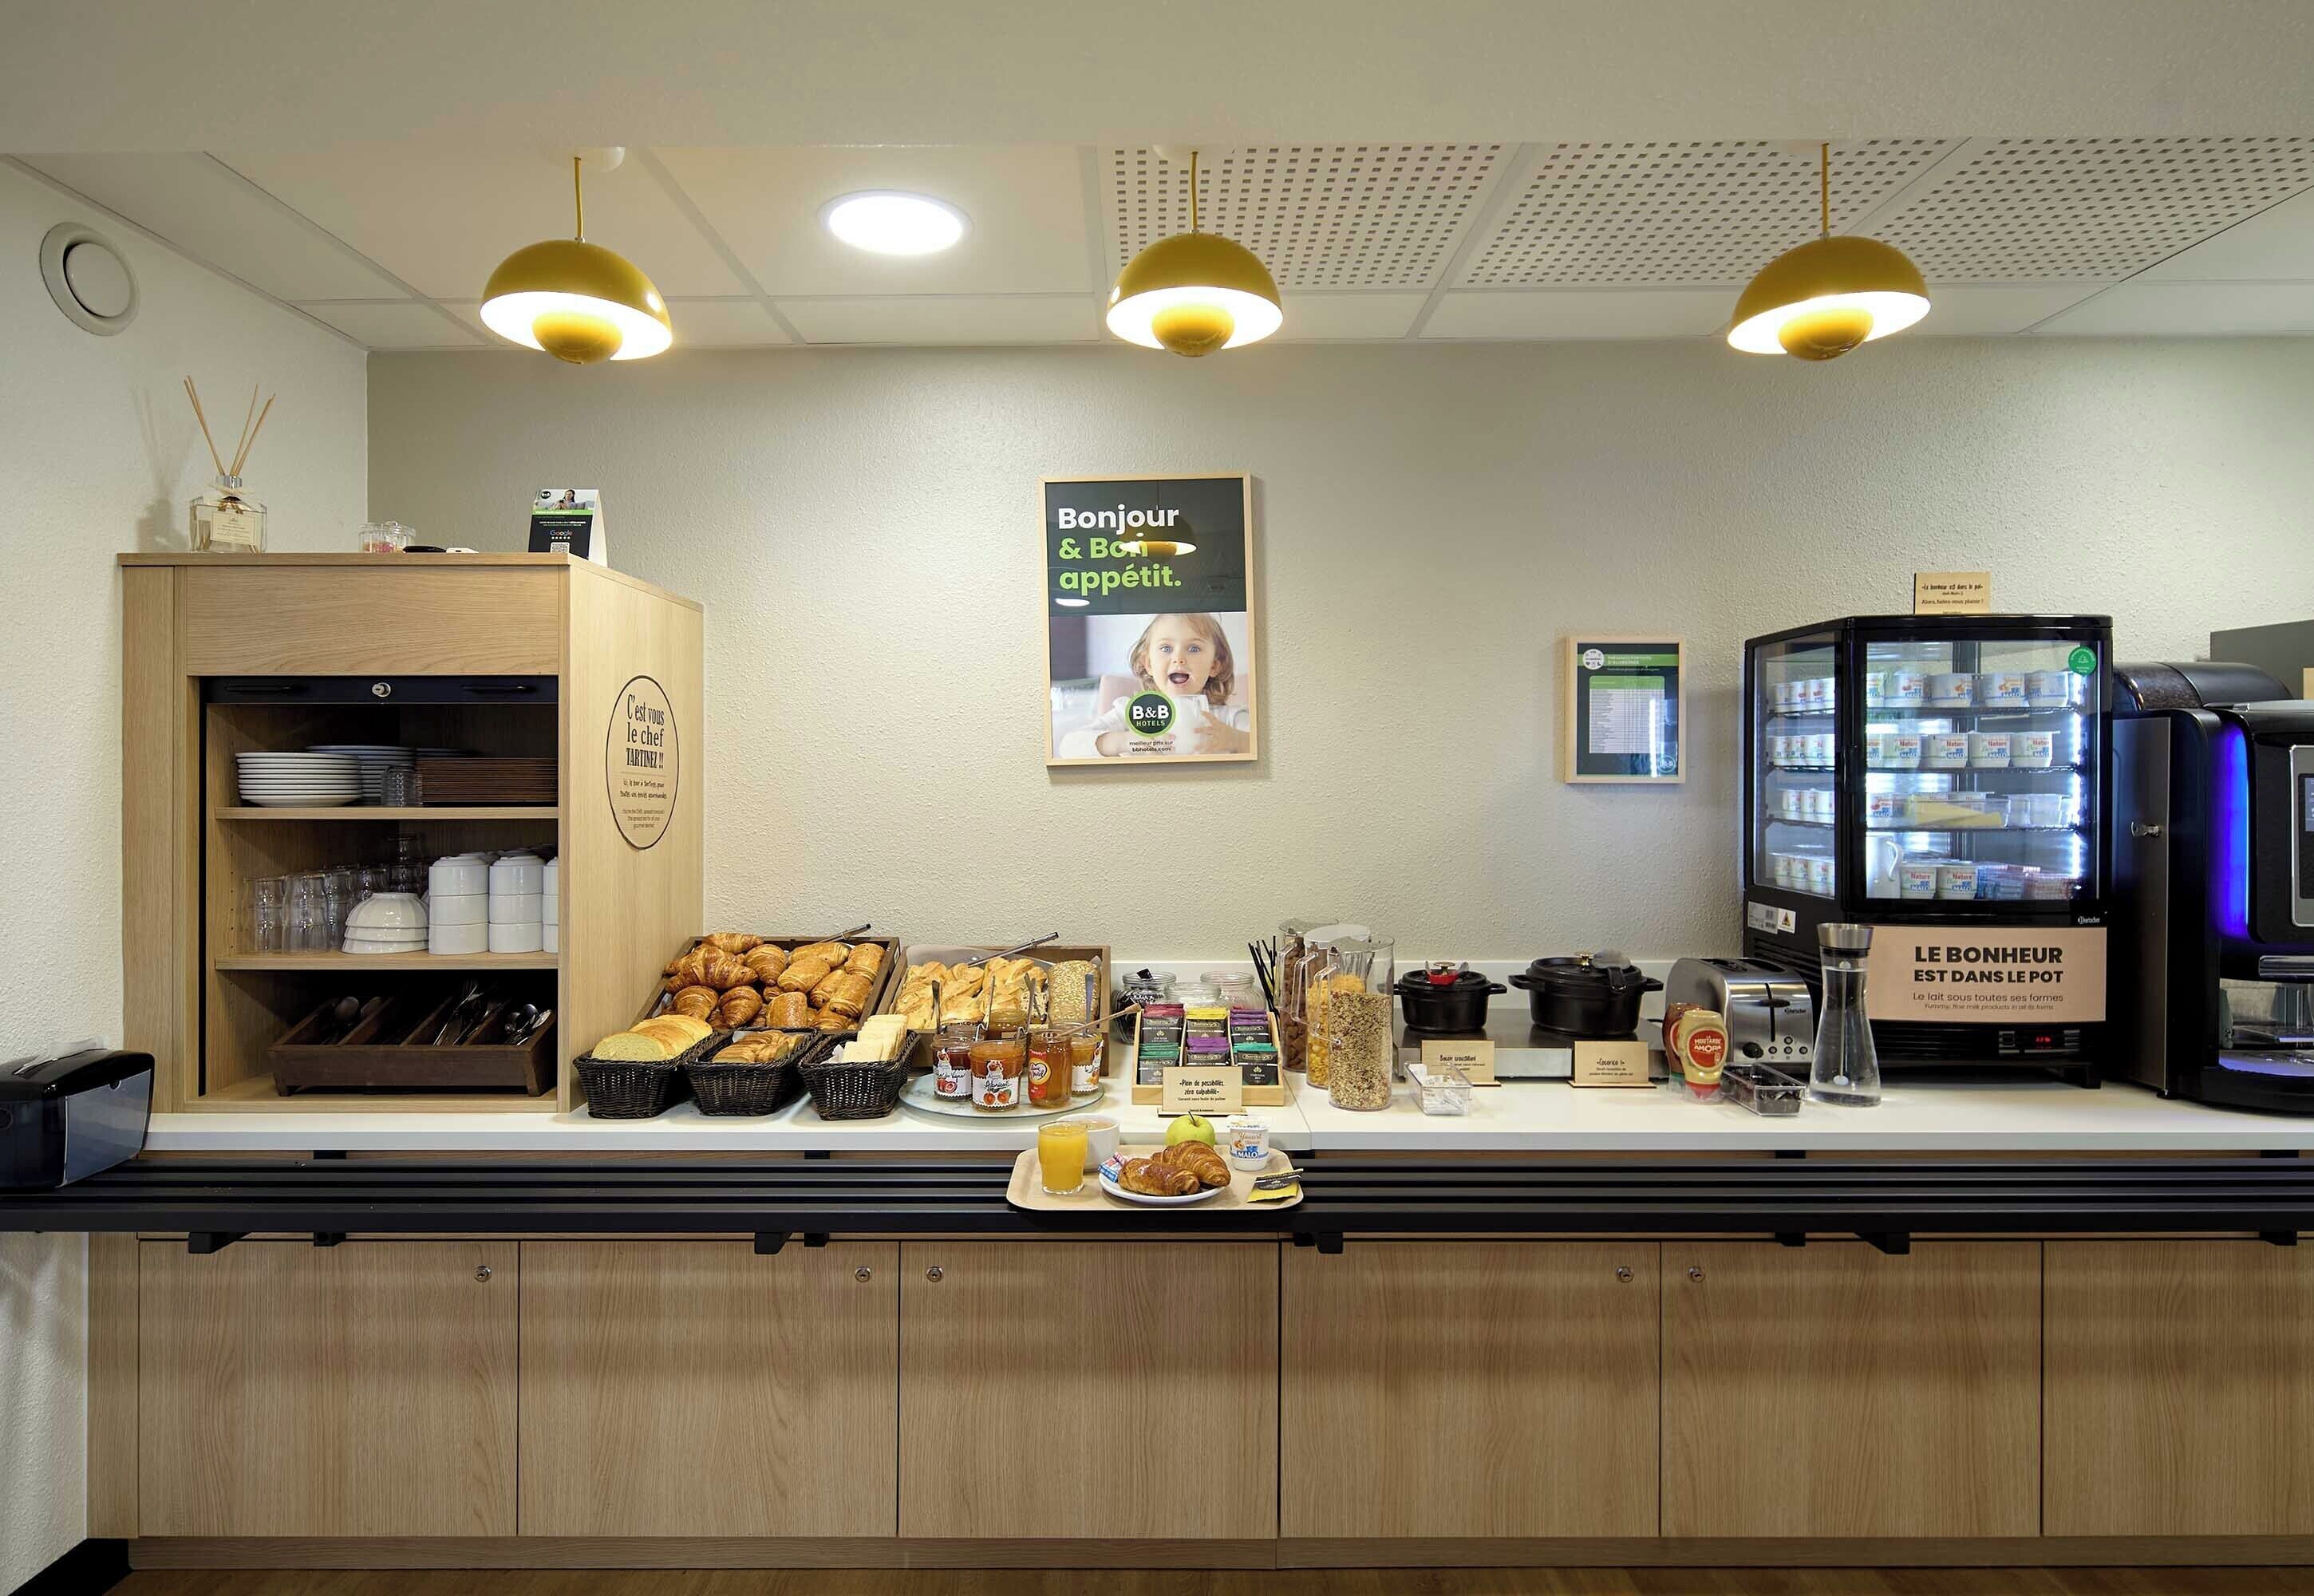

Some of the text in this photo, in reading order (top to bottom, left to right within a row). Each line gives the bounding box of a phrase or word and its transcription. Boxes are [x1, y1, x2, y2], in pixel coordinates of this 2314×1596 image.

[1058, 504, 1179, 535] Bonjour
[1059, 537, 1083, 559] &
[1059, 563, 1182, 595] appétit.
[627, 694, 665, 725] C'est vous
[1132, 705, 1169, 720] B&B
[627, 722, 664, 747] le chef
[626, 748, 657, 768] TARTINEZ
[1915, 946, 2063, 964] LE BONHEUR
[1914, 970, 2063, 983] EST DANS LE POT
[1913, 992, 1925, 1001] Le
[1928, 992, 1944, 1001] lait
[1974, 993, 2008, 1001] toutes
[2029, 992, 2063, 1001] formes
